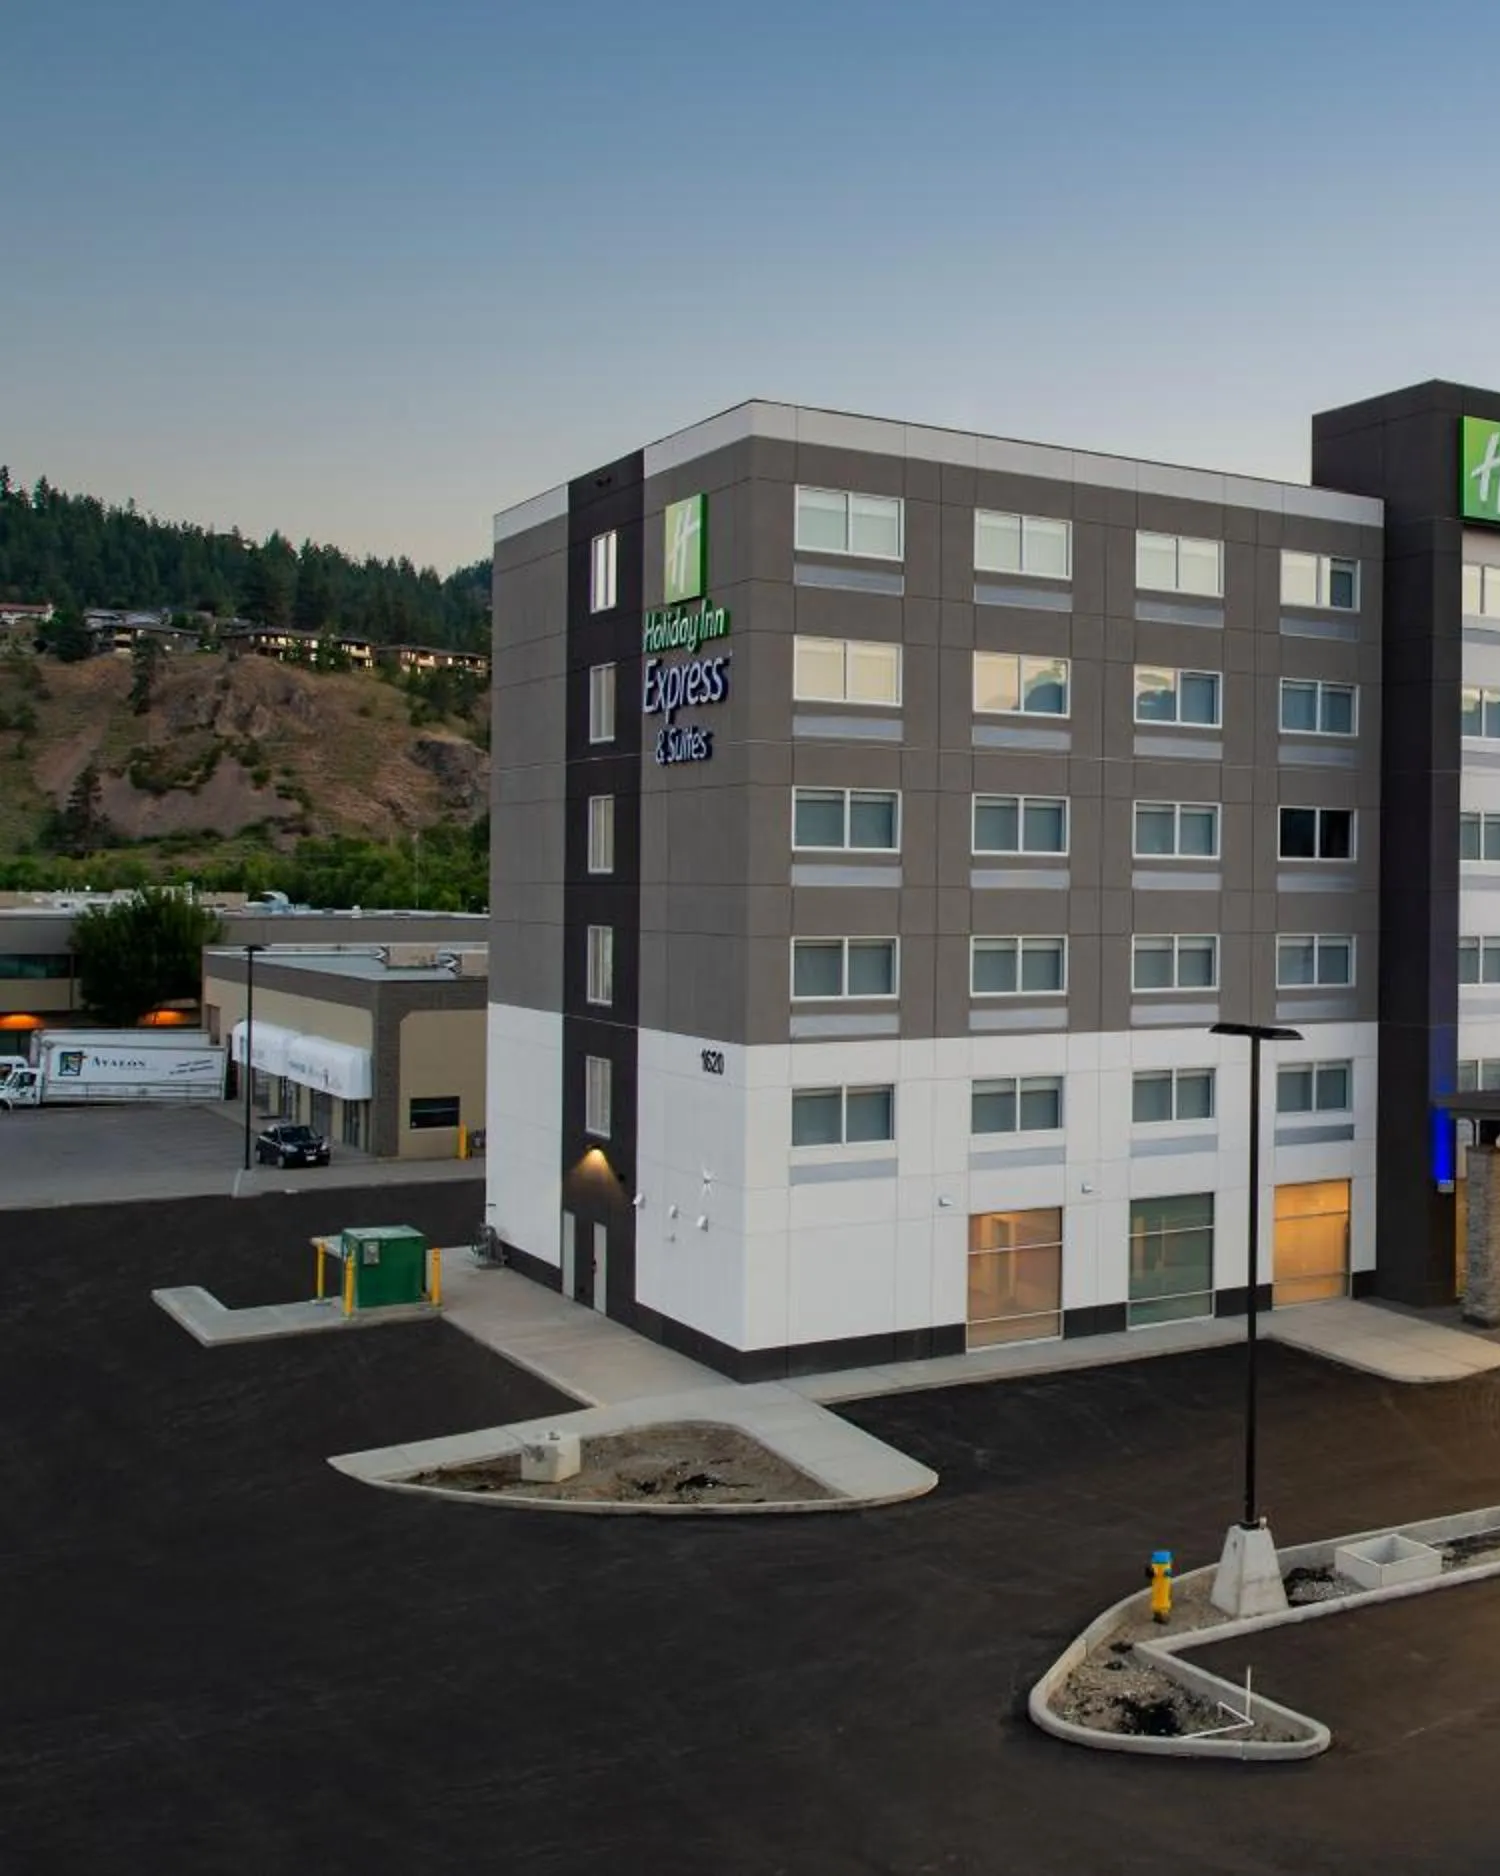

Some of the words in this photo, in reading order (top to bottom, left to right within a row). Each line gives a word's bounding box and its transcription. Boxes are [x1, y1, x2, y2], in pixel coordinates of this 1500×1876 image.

[643, 607, 699, 653] Holiday
[700, 599, 725, 641] Inn
[643, 656, 724, 723] Express
[655, 730, 666, 764] &
[667, 726, 708, 763] Suites
[701, 1048, 725, 1076] 1620
